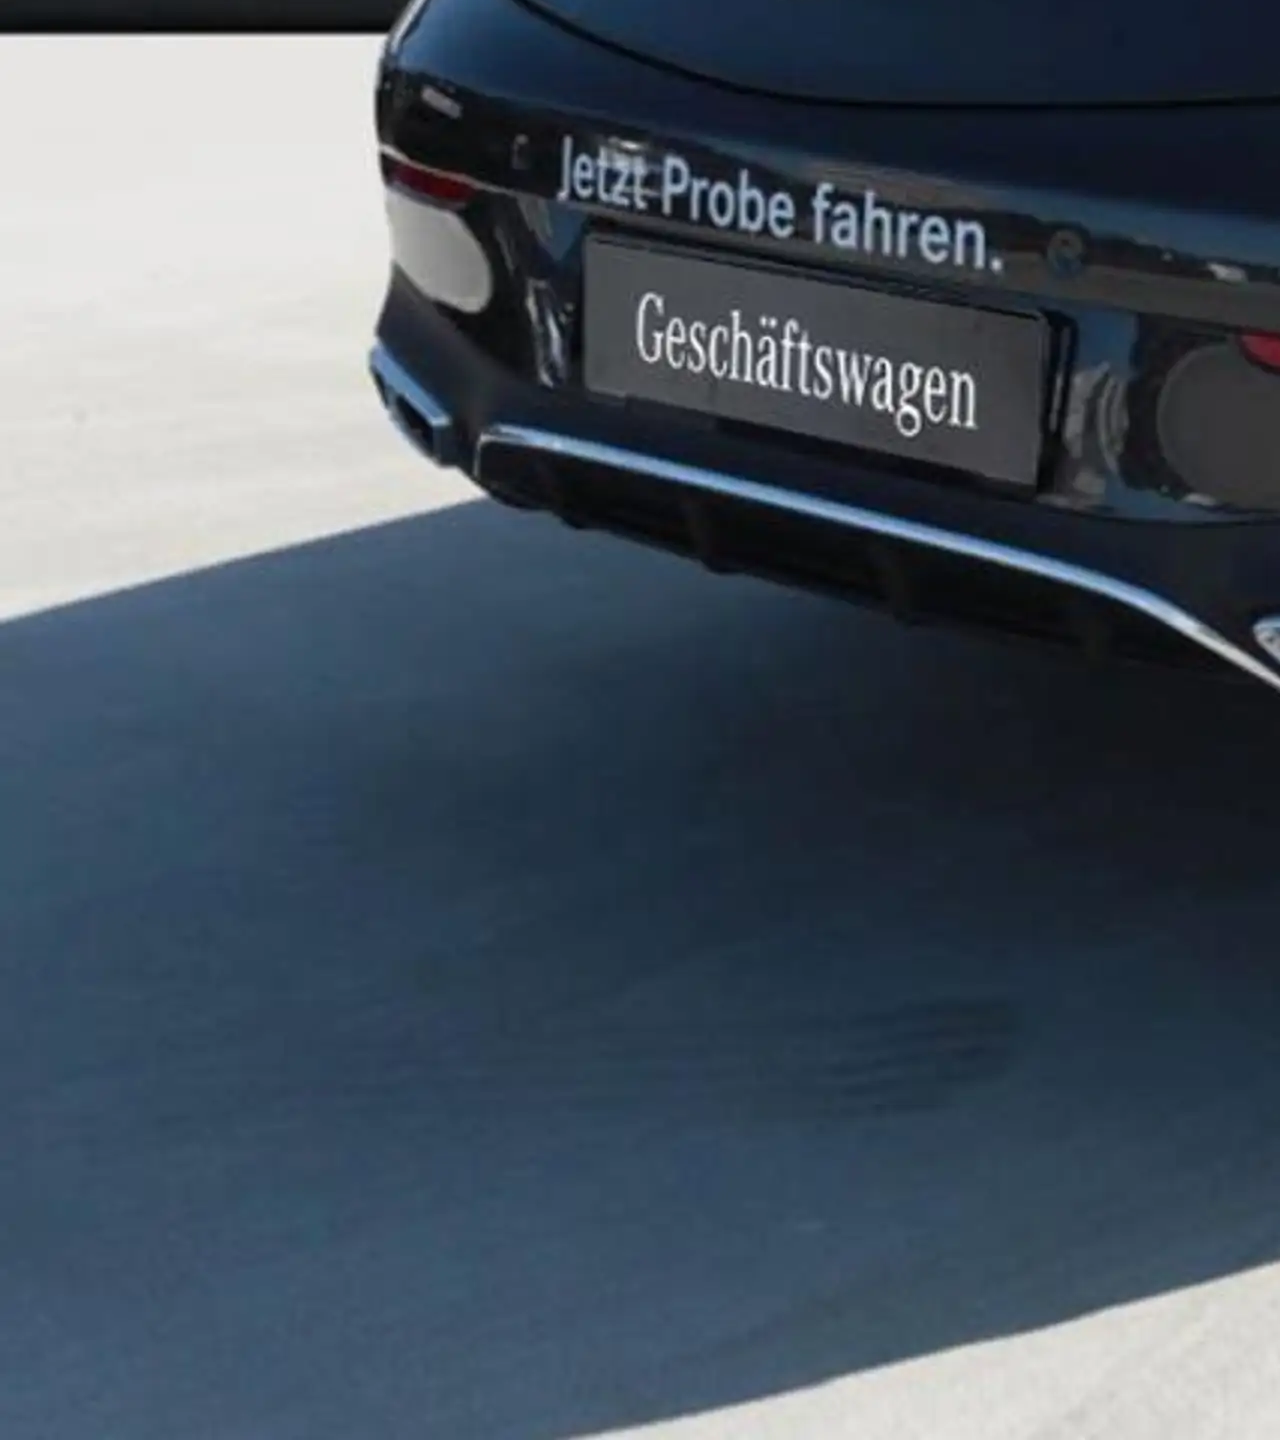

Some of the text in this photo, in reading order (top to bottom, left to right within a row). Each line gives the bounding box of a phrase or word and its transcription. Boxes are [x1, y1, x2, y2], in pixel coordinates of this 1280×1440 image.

[558, 135, 1002, 273] Jetzt Probe fahren.
[635, 291, 977, 437] Geschäftswagen
